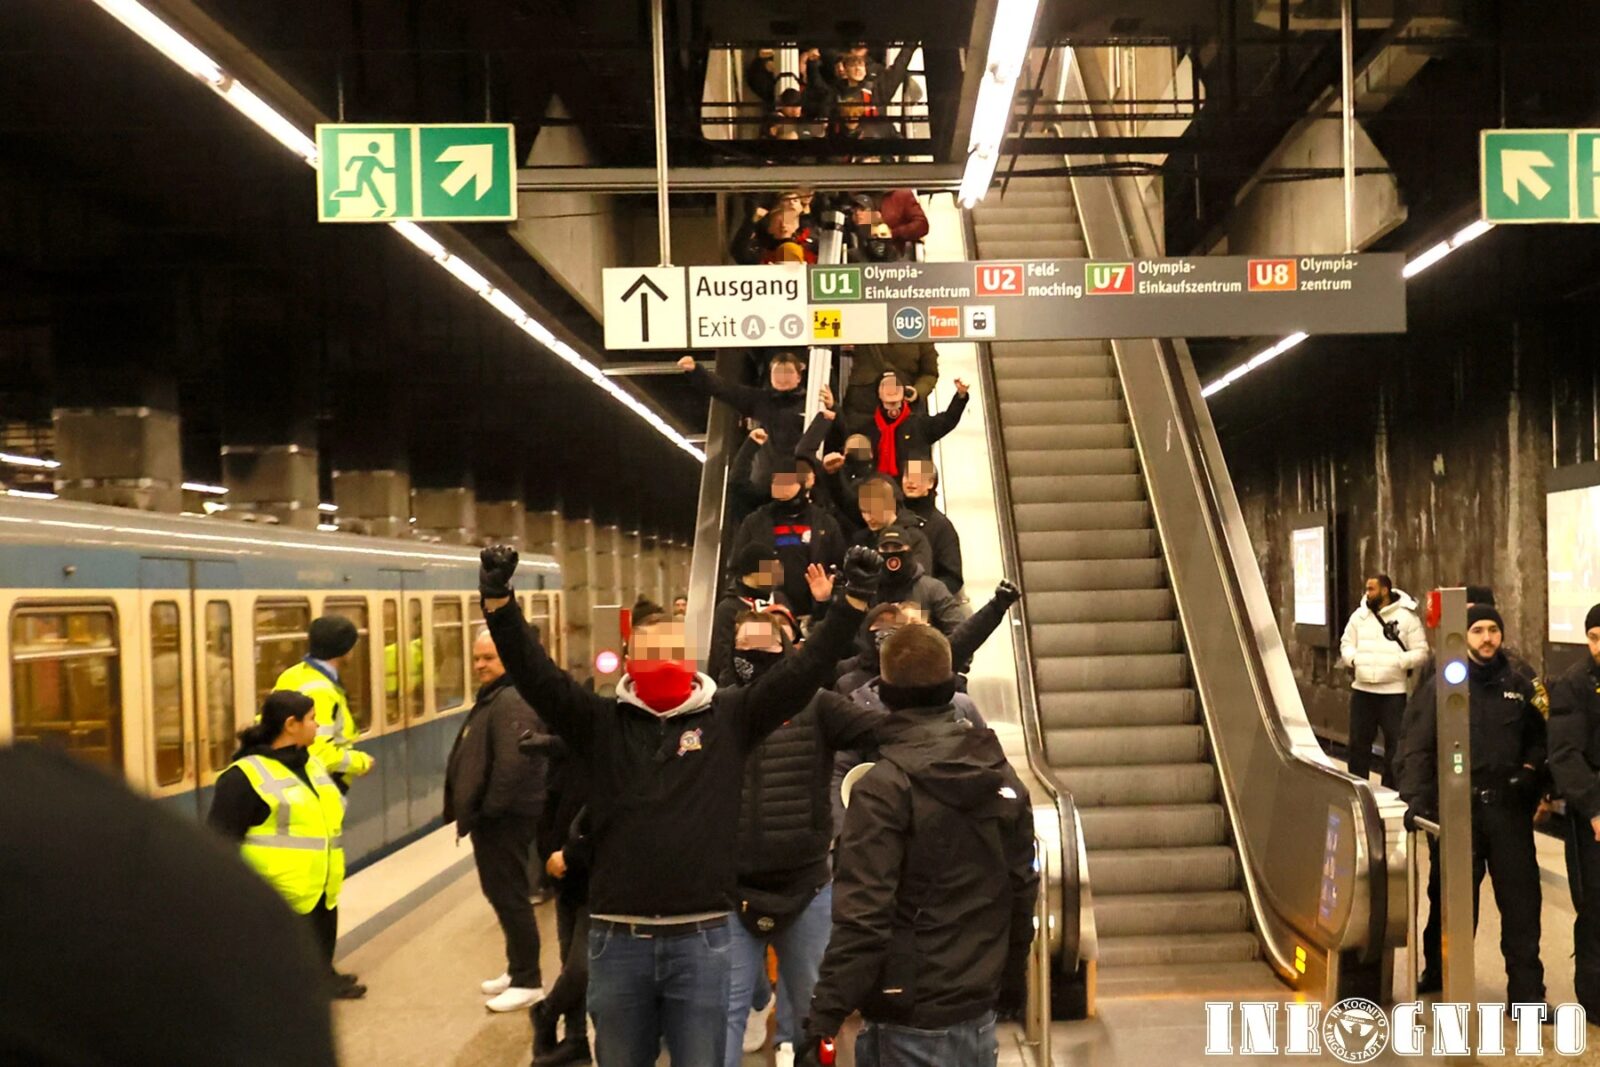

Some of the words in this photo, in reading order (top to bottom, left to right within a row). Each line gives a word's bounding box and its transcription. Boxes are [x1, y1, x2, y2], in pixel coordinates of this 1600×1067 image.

[1028, 263, 1060, 277] Feld-
[1138, 260, 1195, 276] Olympia-
[1300, 257, 1358, 273] Olympia-
[864, 266, 923, 282] Olympia-
[983, 268, 1016, 290] U2
[1093, 268, 1126, 289] U7
[1255, 263, 1289, 285] U8
[696, 276, 798, 301] Ausgang
[819, 273, 853, 295] U1
[1028, 282, 1082, 299] moching
[1138, 278, 1242, 295] Einkaufszentrum
[1300, 277, 1352, 291] zentrum
[864, 285, 971, 301] Einkaufszentrum
[698, 316, 737, 338] Exit
[896, 316, 923, 331] BUS
[929, 315, 959, 328] Tram
